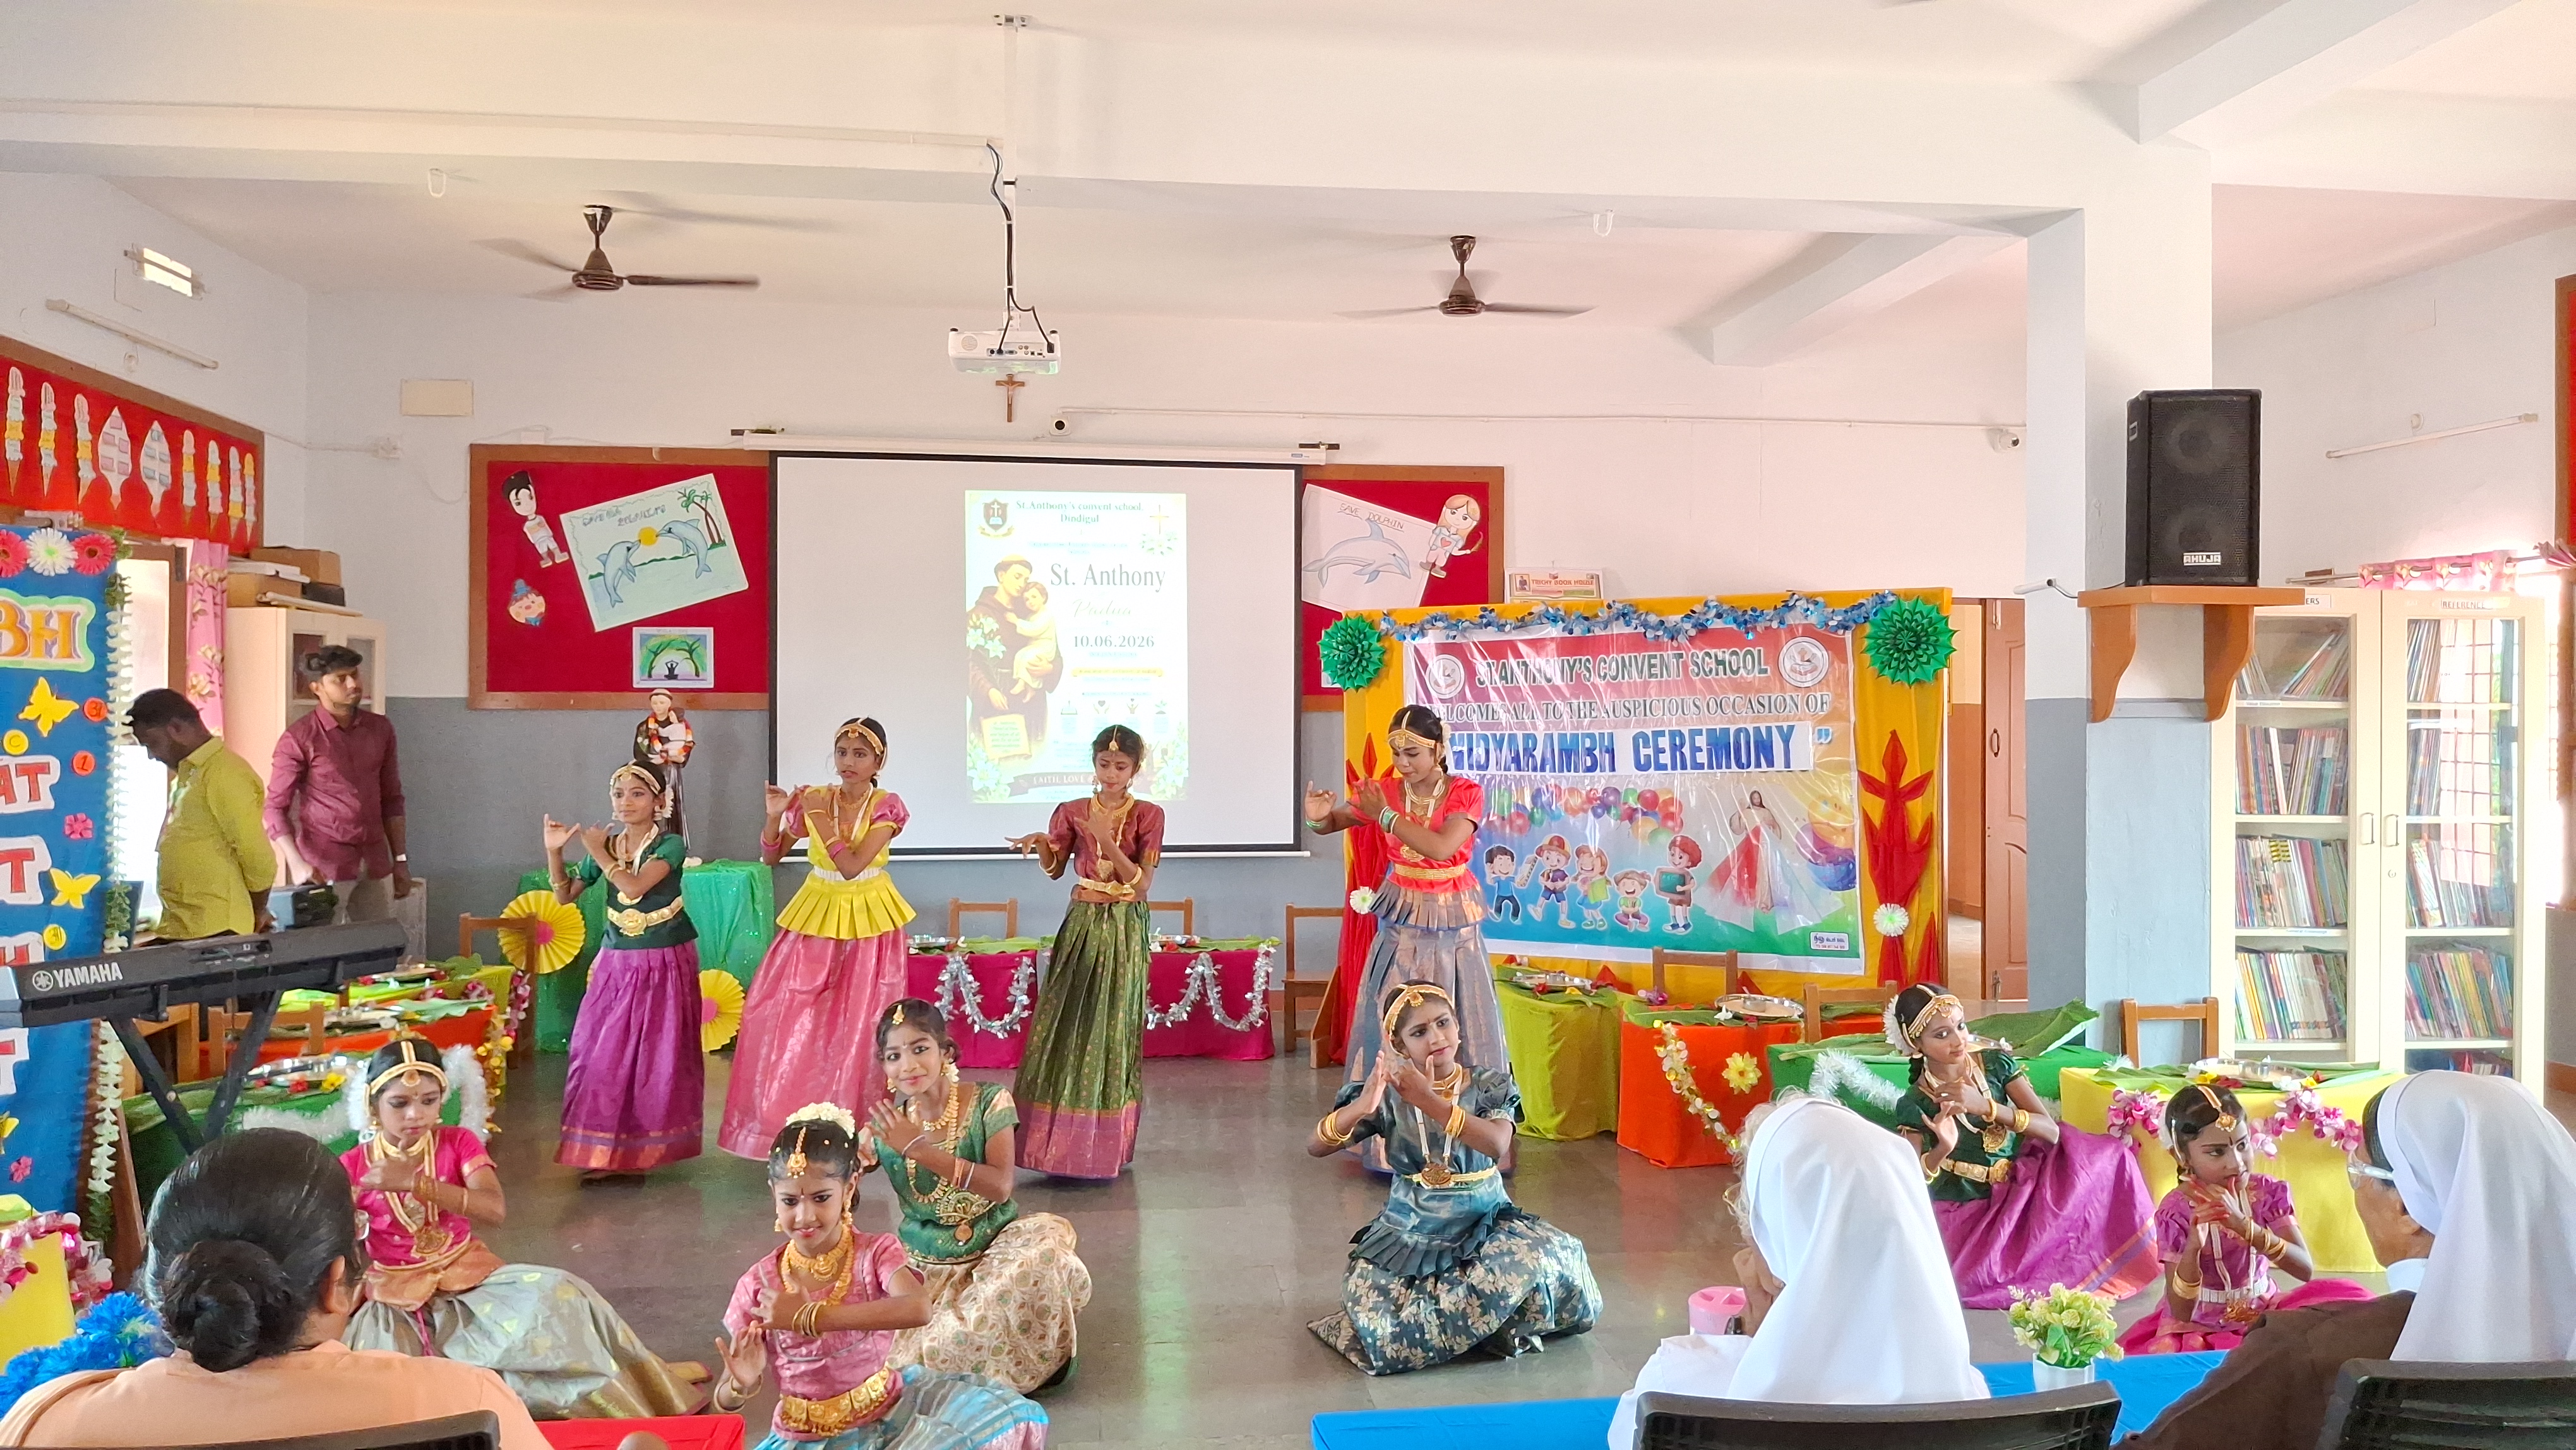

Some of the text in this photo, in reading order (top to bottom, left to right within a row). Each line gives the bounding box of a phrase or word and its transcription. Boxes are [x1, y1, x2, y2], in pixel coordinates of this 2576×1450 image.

[1061, 513, 1099, 524] Dindigul
[1339, 503, 1404, 529] SAVE DOLPHIN
[2183, 554, 2221, 563] AHUJA
[1051, 563, 1166, 593] St. Anthony
[1072, 599, 1131, 618] Padua
[1074, 635, 1155, 647] 10.06.2026
[1597, 652, 1685, 683] CONVENT
[1690, 647, 1769, 678] SCHOOL
[1542, 702, 1563, 720] TO
[1567, 700, 1599, 719] THE
[1602, 697, 1702, 719] AUSPICIOUS
[1706, 693, 1801, 716] OCCASION
[1805, 693, 1830, 714] OF
[1449, 731, 1616, 773] VIDYARAMBH
[1631, 724, 1796, 772] CEREMONY
[53, 962, 123, 988] YAMAHA
